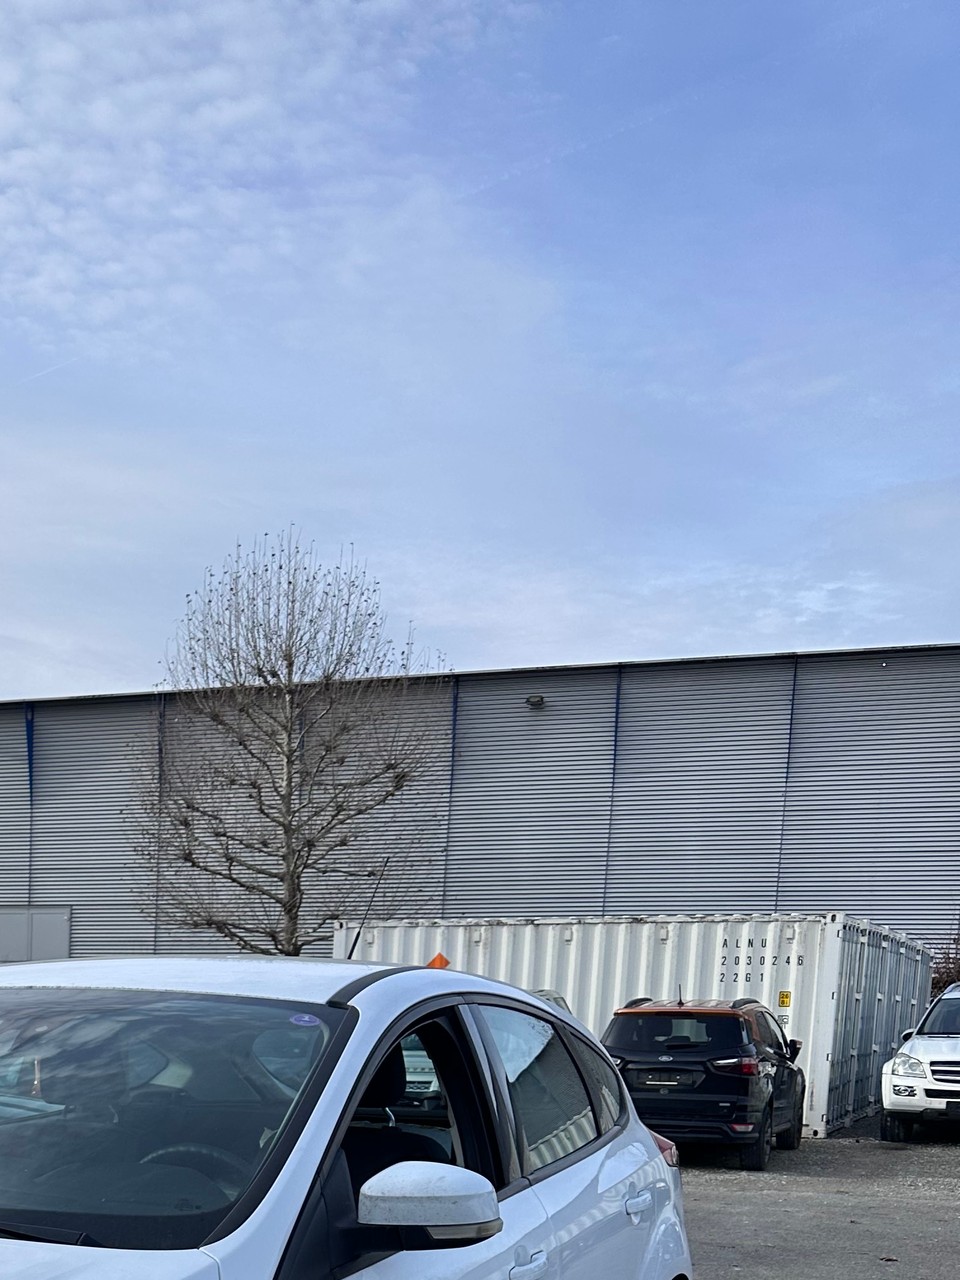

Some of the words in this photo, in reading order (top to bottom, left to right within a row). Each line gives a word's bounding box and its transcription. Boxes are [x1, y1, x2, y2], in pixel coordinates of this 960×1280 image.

[722, 938, 767, 948] ALNU
[721, 956, 804, 966] 2030246
[720, 973, 764, 982] 22G1
